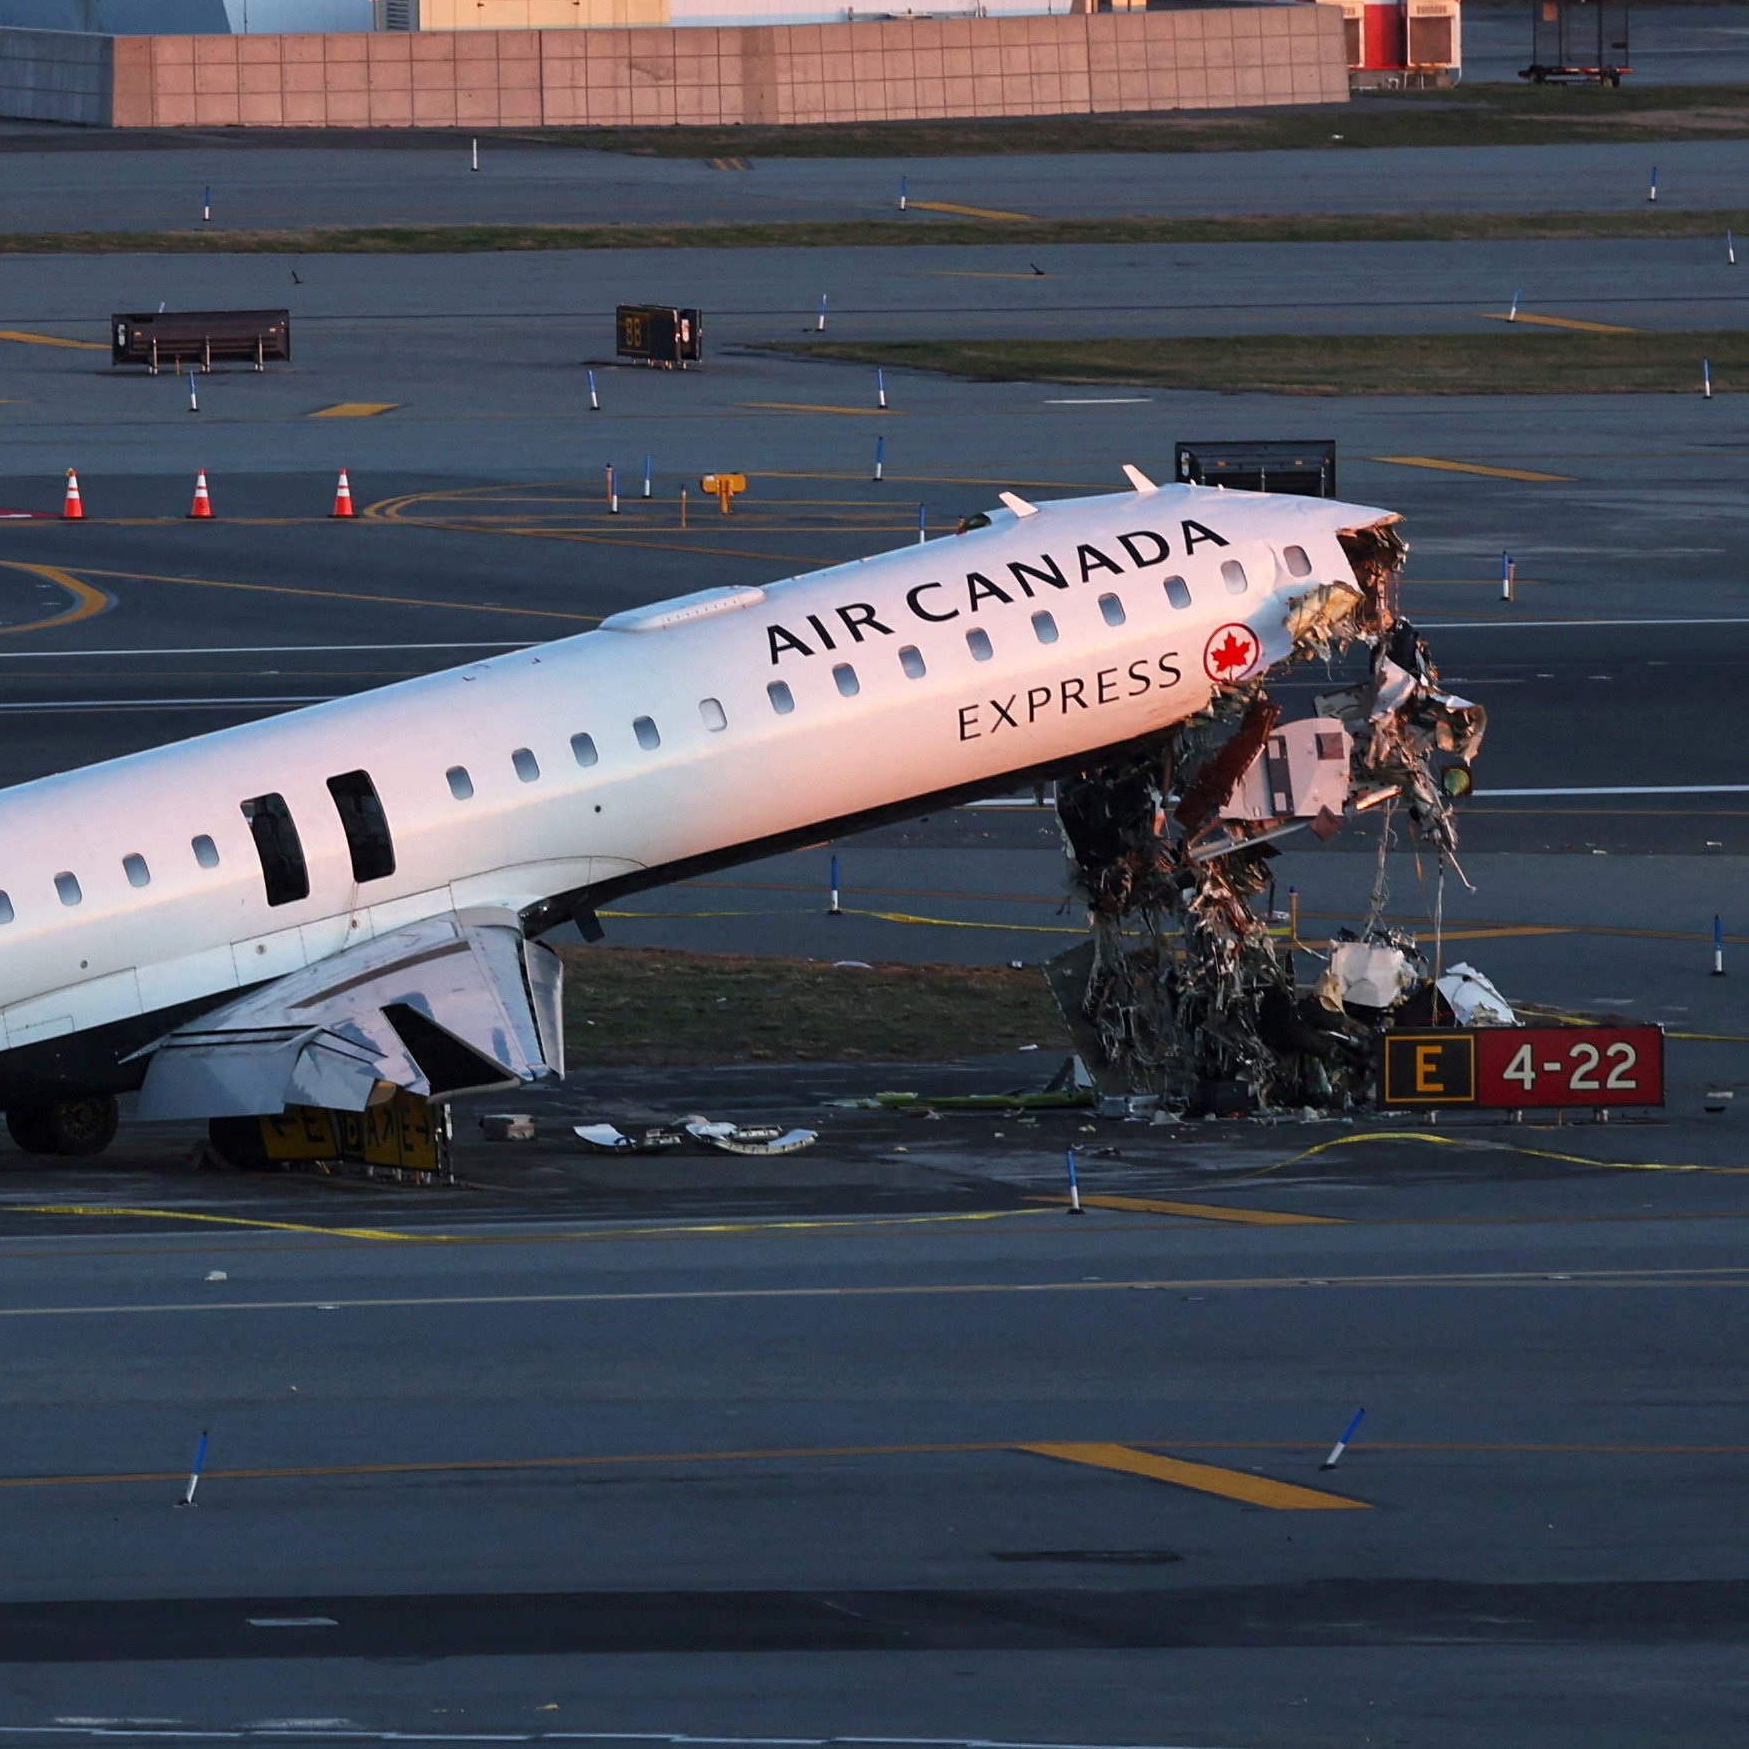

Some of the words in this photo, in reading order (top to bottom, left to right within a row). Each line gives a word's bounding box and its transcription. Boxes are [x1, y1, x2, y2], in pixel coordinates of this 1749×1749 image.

[766, 602, 895, 665] AIR
[904, 518, 1230, 624] CANADA
[957, 651, 1184, 741] EXPRESS
[1415, 1045, 1444, 1093] E
[1502, 1043, 1639, 1091] 4-22
[401, 1106, 414, 1152] E
